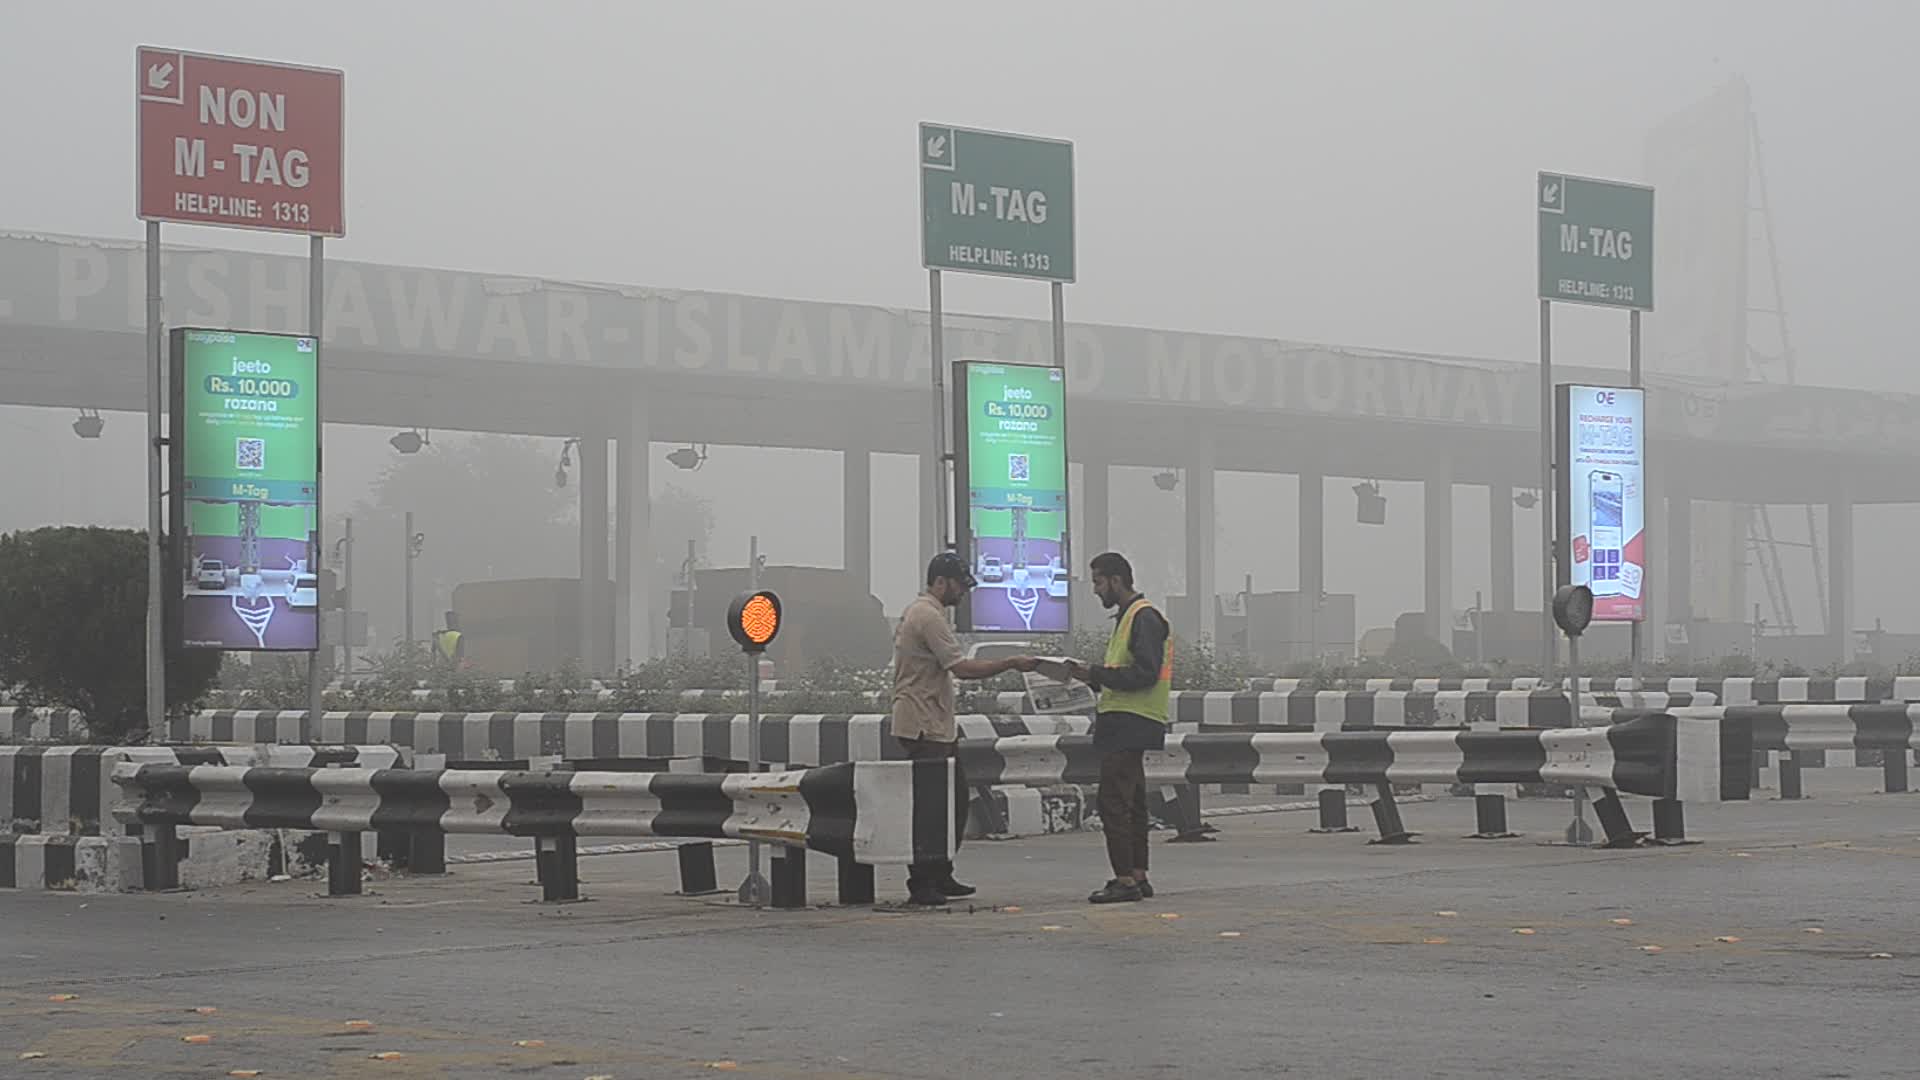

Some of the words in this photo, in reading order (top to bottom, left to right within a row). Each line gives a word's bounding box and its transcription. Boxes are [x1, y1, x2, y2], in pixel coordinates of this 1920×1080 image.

[200, 85, 285, 131] NON
[175, 192, 262, 218] HELPLINE:
[272, 202, 310, 223] 1313
[951, 182, 1047, 223] M-TAG
[1560, 223, 1632, 260] M-TAG
[949, 245, 1017, 267] HELPLINE:
[1022, 252, 1050, 270] 1313
[231, 356, 271, 376] jeeto
[1145, 328, 1521, 425] MOTORWAY
[211, 377, 235, 393] Rs.
[238, 379, 291, 397] 10,000
[1003, 384, 1032, 401] jeeto
[224, 398, 277, 412] rozana
[988, 403, 1006, 417] Rs.
[1008, 404, 1047, 419] 10,000
[999, 420, 1037, 432] rozana
[232, 483, 269, 499] M-Tag
